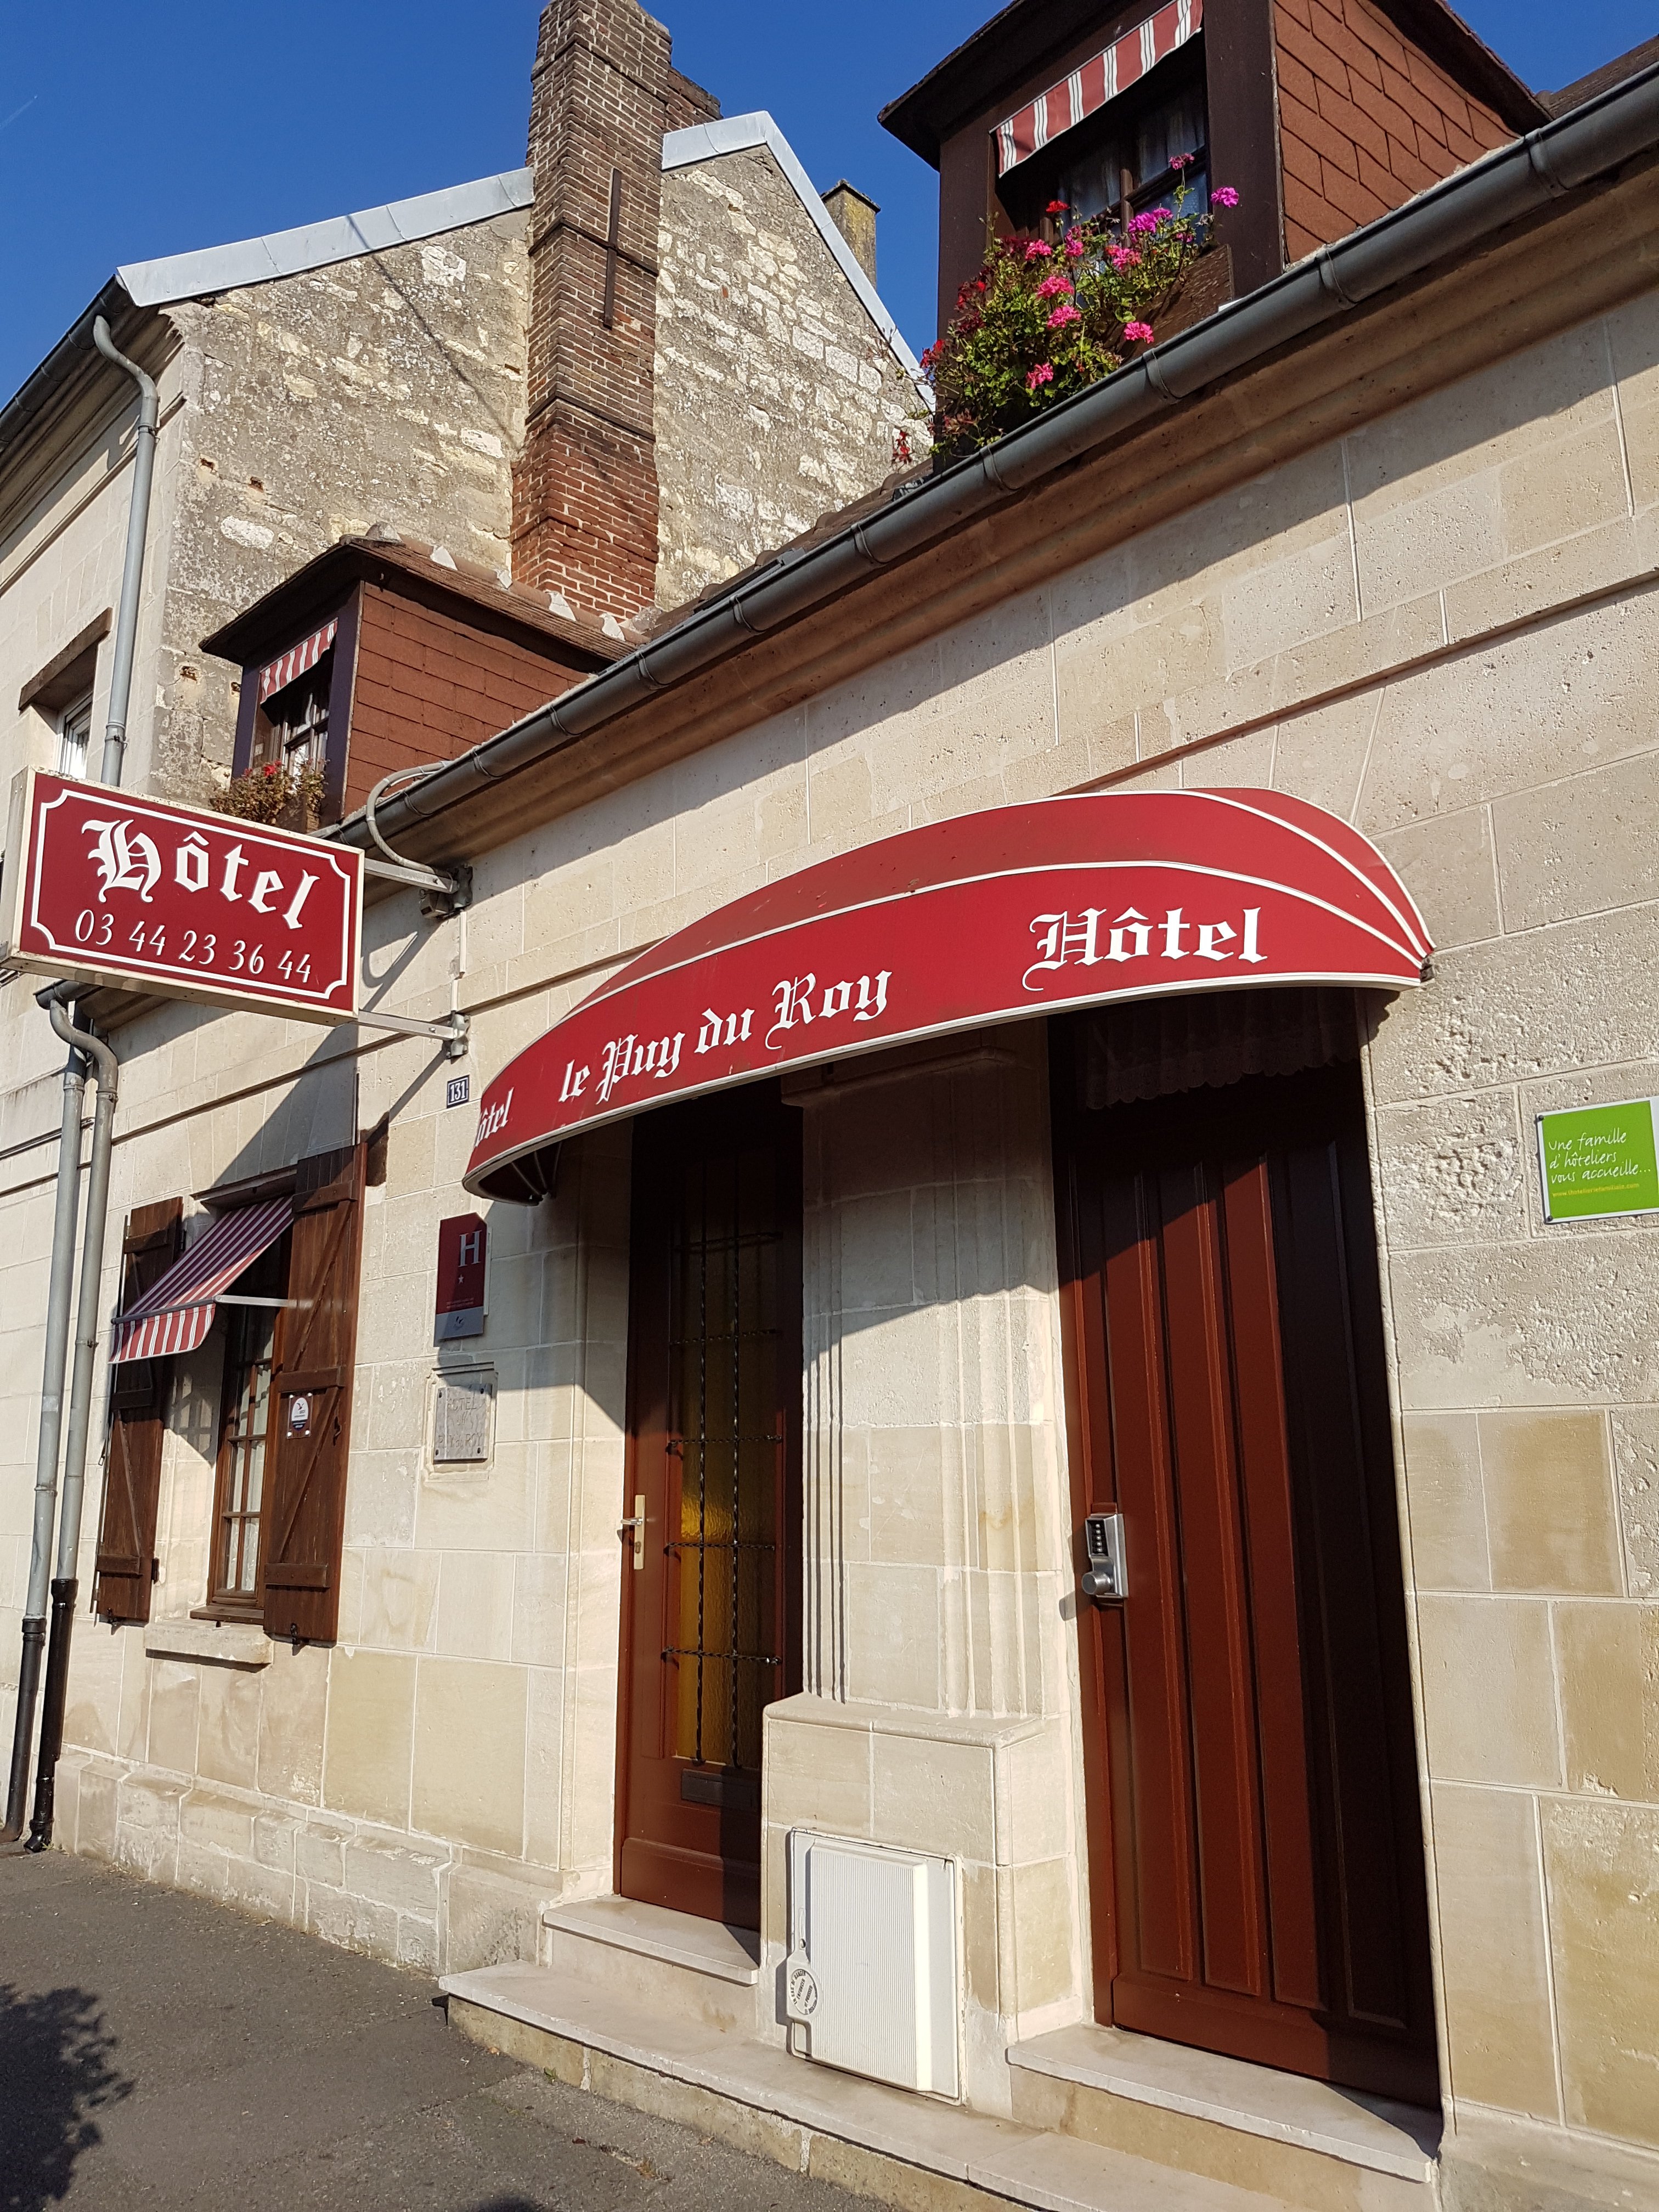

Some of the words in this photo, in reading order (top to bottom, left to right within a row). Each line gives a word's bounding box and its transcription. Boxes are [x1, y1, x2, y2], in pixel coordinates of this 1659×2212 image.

[81, 819, 320, 929] Hôtel
[75, 909, 115, 946] 03
[129, 921, 166, 956] 44
[179, 930, 216, 965] 23
[229, 940, 265, 975] 36
[278, 950, 311, 983] 44
[1022, 906, 1268, 991] Hôtel
[558, 1060, 590, 1103] le
[596, 1033, 685, 1105] Puy
[693, 1008, 755, 1054] du
[765, 969, 893, 1049] Roy
[450, 1081, 465, 1102] 131
[475, 1087, 515, 1147] ôtel
[1577, 1127, 1627, 1151] famille
[1551, 1171, 1575, 1184] vous
[458, 1229, 482, 1267] H
